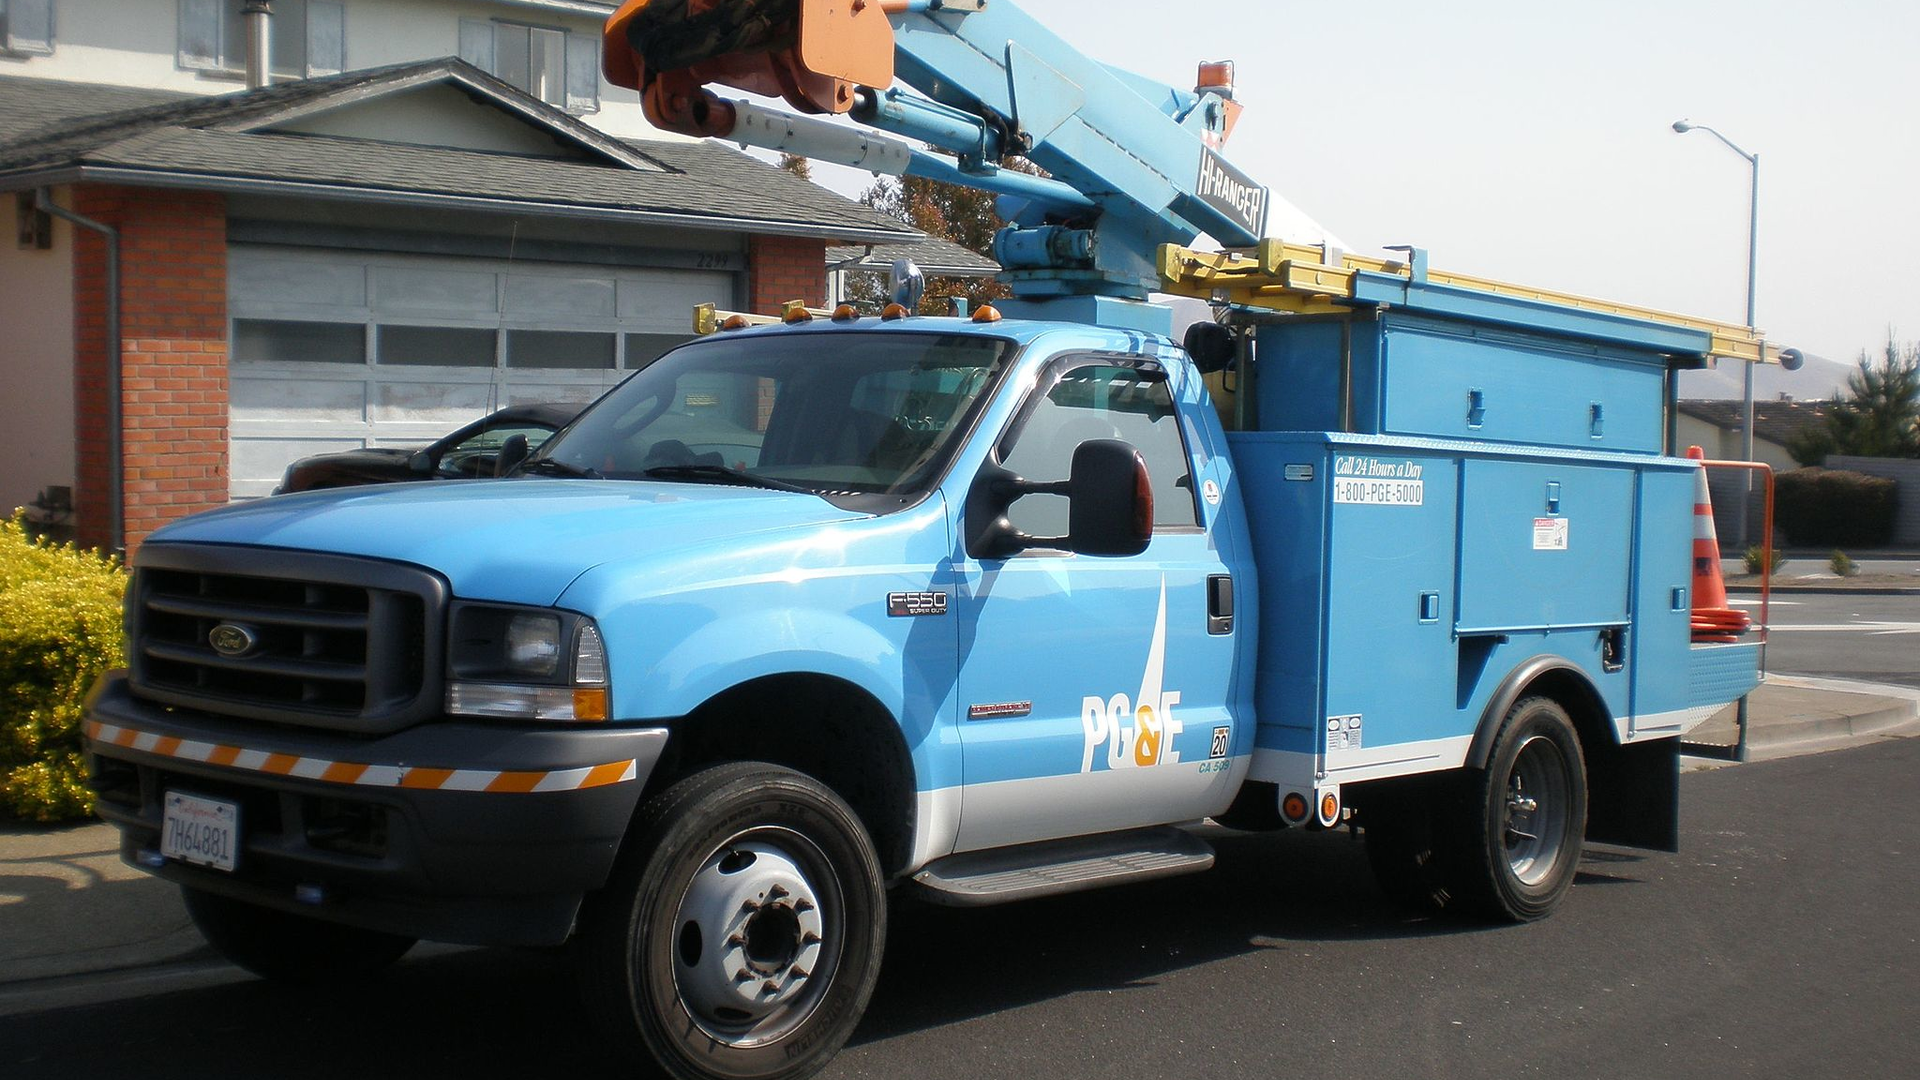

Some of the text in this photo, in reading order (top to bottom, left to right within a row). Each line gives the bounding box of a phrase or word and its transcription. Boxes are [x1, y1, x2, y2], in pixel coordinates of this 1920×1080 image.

[1198, 147, 1261, 233] HI-RANGER
[1335, 456, 1422, 480] Call 24 Hours a Day
[1336, 482, 1421, 503] 1-800-PGE-5000
[1081, 691, 1183, 773] PG&E
[1212, 735, 1227, 755] 20
[1199, 762, 1211, 773] CA
[168, 817, 228, 860] 7H64881
